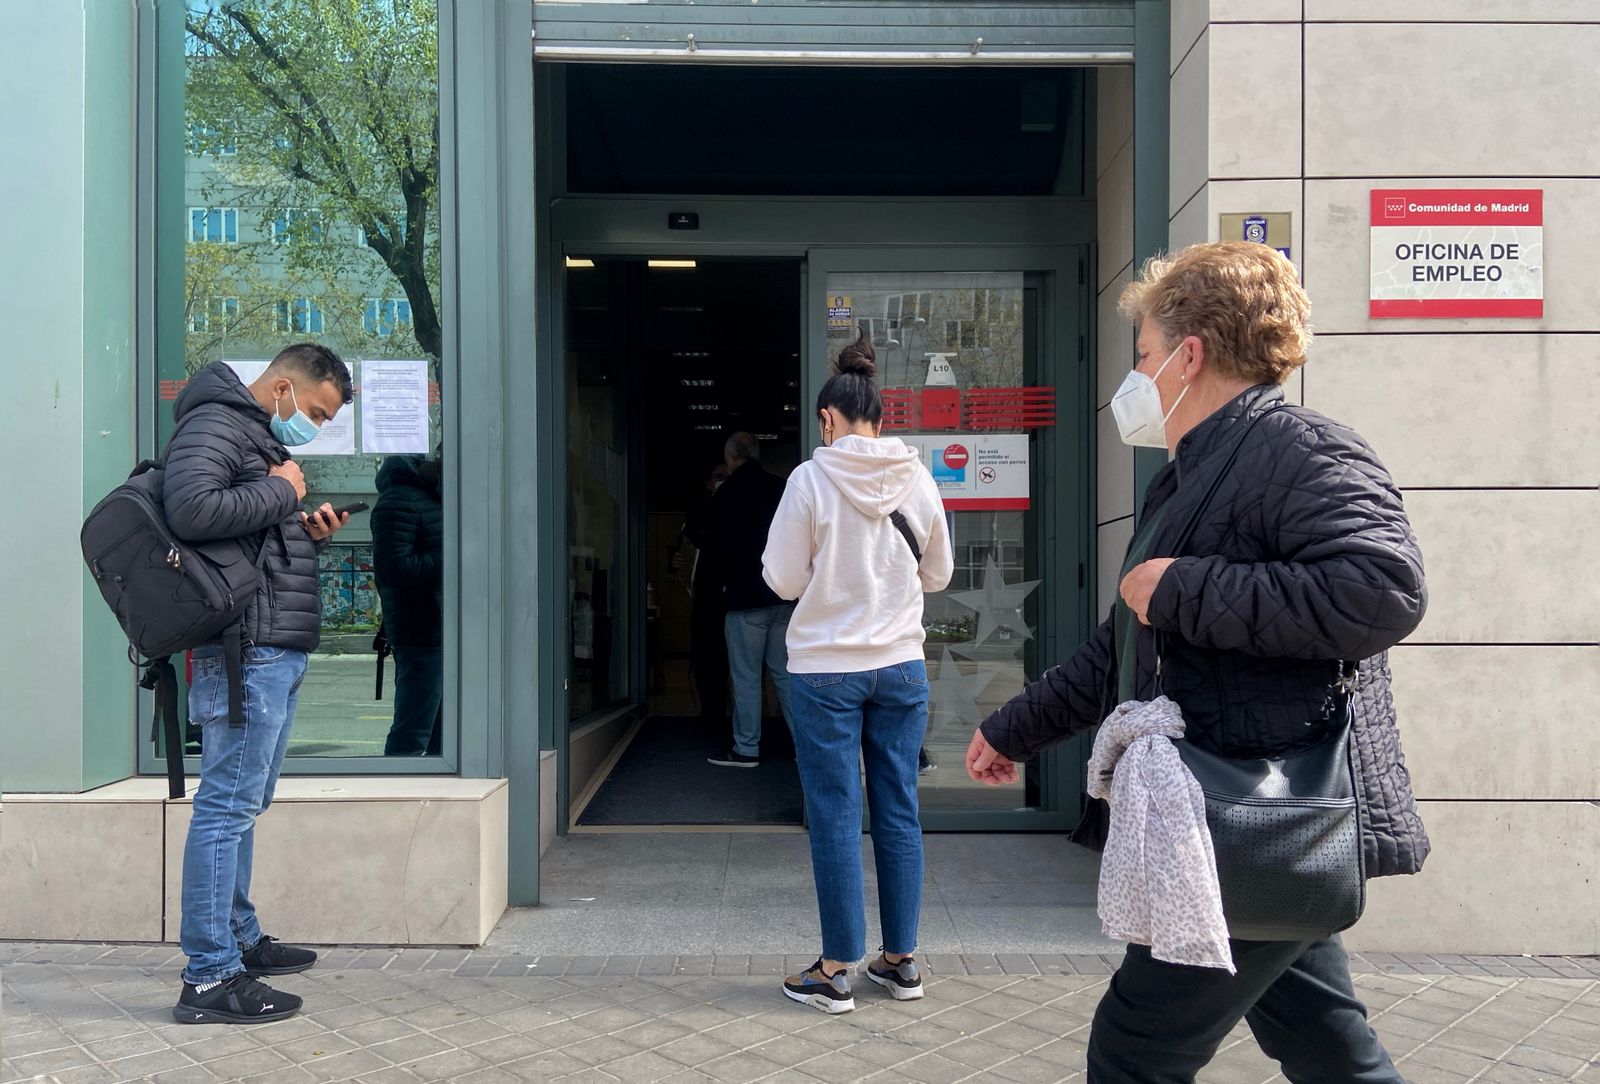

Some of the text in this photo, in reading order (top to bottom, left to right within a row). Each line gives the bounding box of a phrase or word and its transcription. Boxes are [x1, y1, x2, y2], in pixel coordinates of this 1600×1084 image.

[1408, 203, 1530, 213] Comunidad de Madrid
[1395, 243, 1519, 260] OFICINA DE
[1412, 265, 1503, 282] EMPLEO
